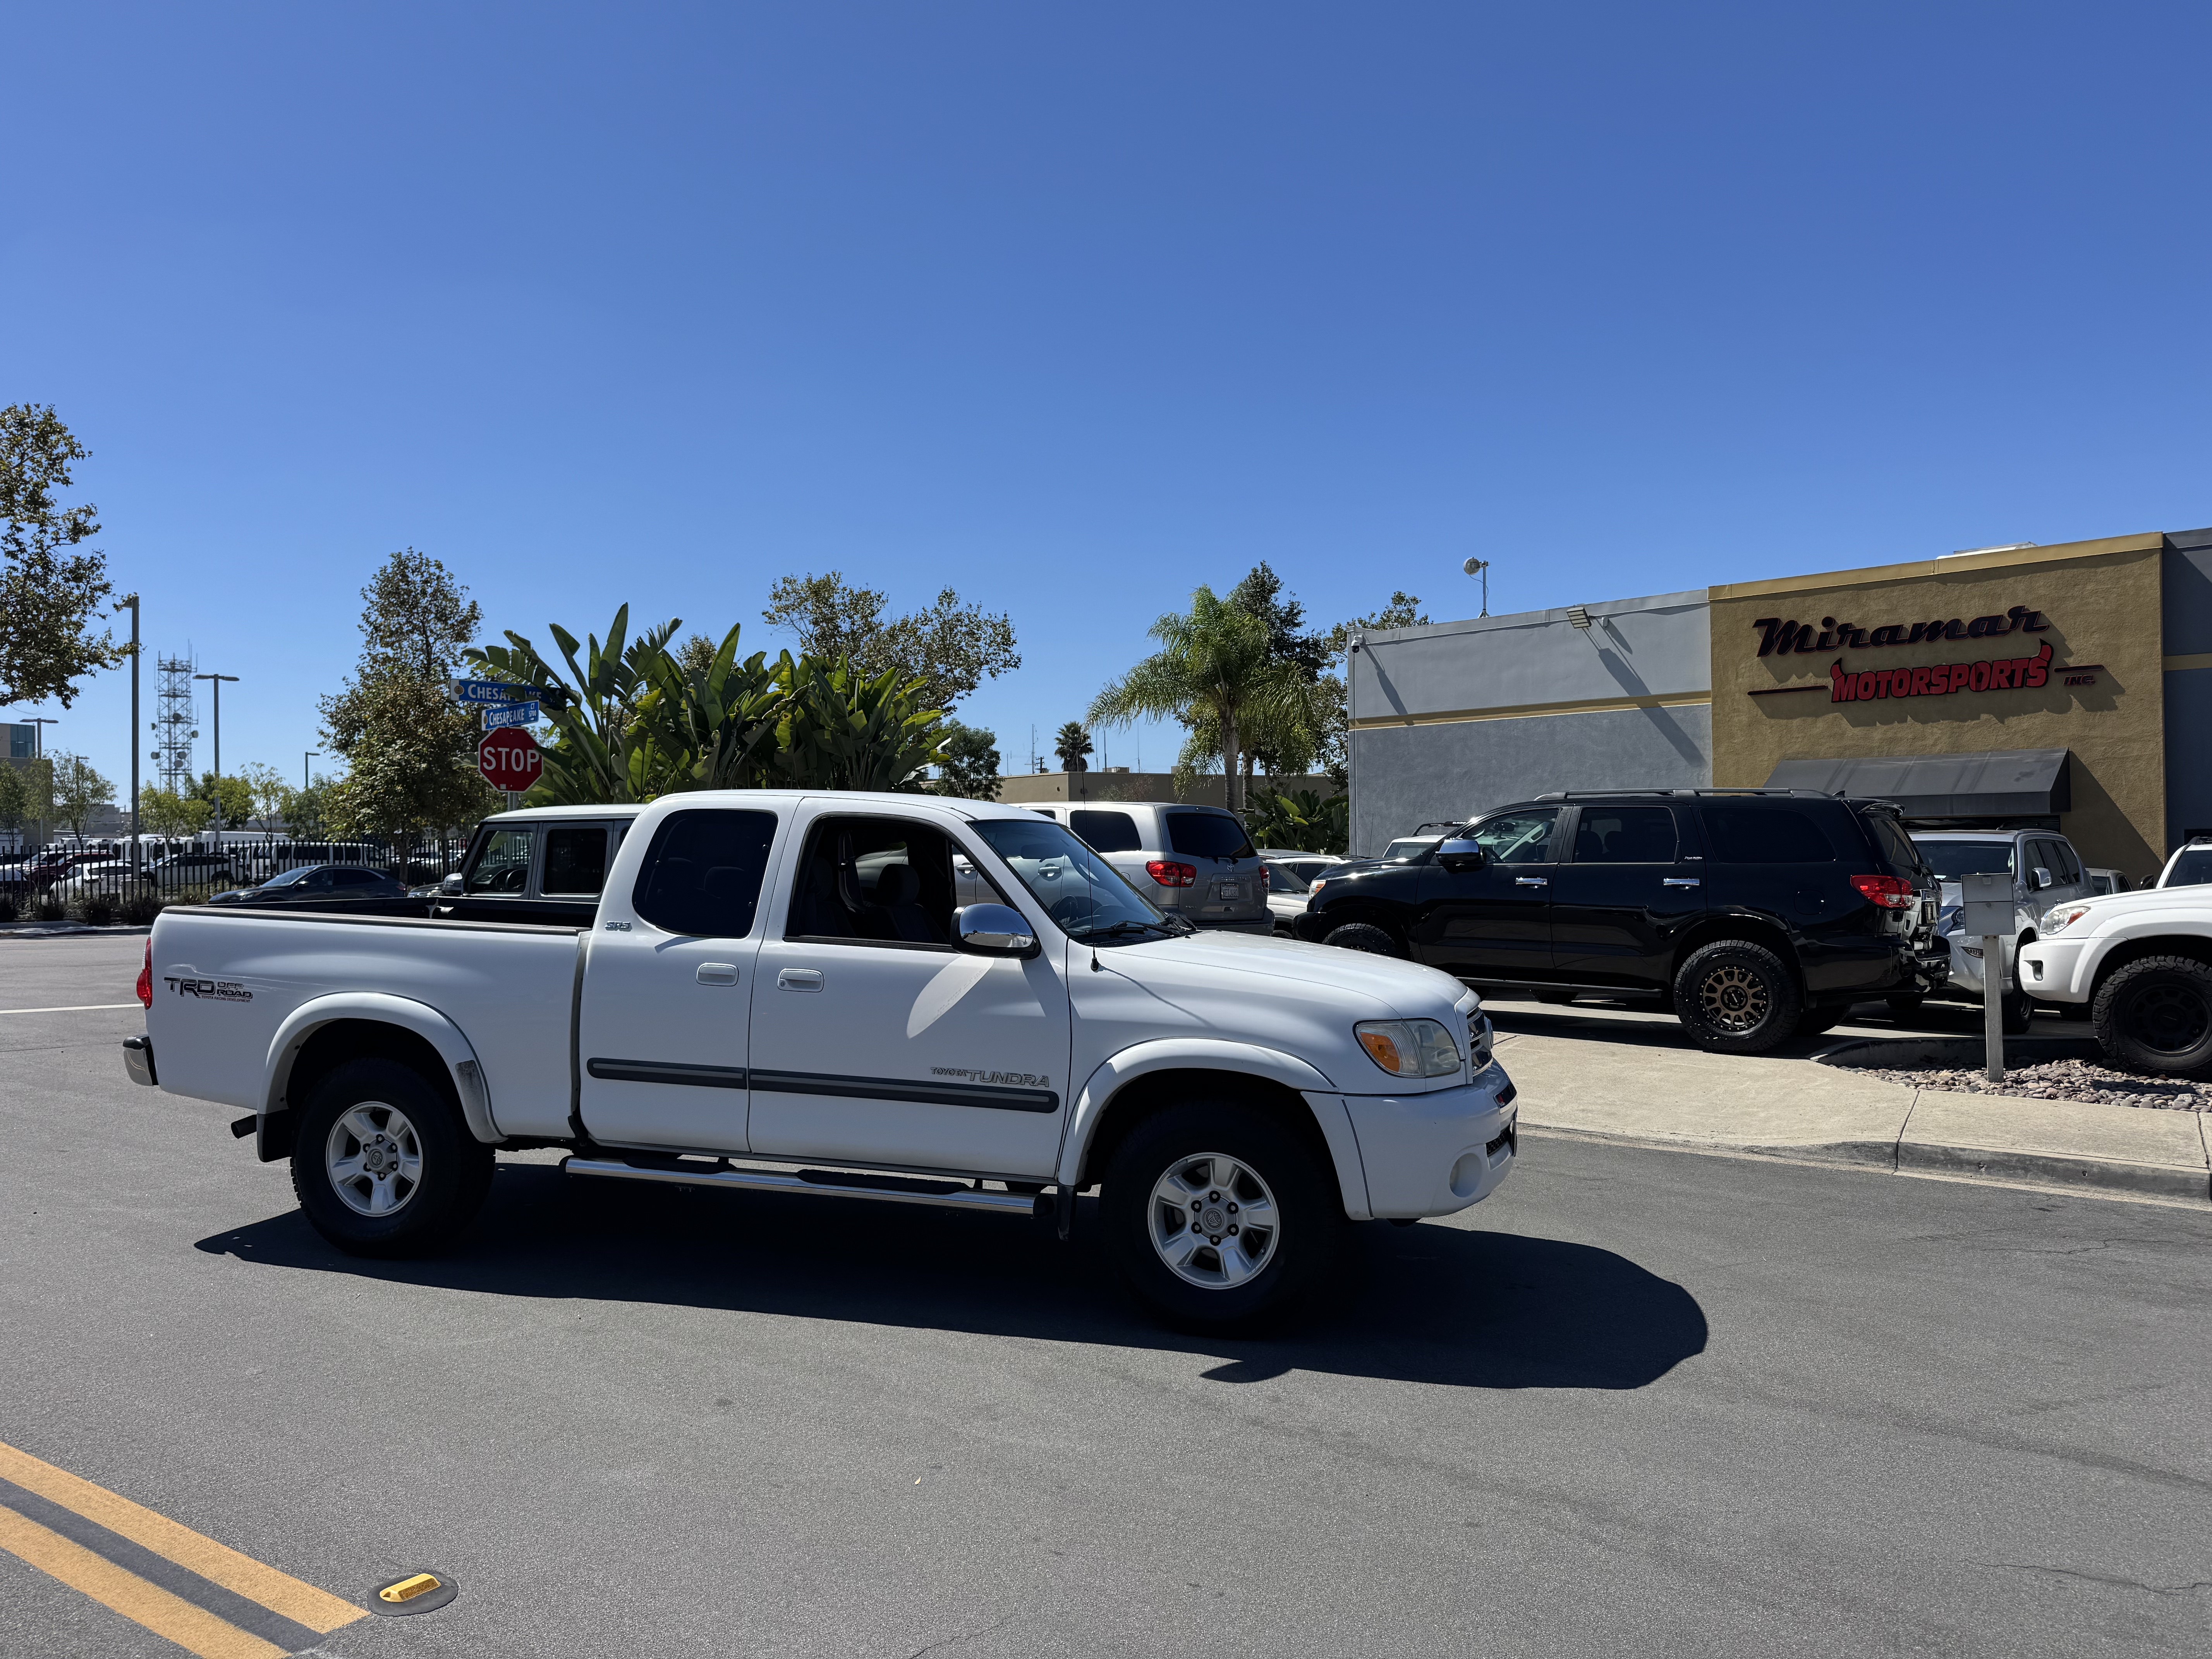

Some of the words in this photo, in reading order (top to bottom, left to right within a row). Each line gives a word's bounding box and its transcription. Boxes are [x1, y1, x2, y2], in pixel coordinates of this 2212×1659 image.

[1752, 605, 2049, 658] Miramar
[1831, 652, 2051, 703] MOTORSPORTS
[2063, 675, 2095, 686] INC.
[489, 709, 524, 726] CHESAPEAKE
[483, 747, 539, 772] STOP
[605, 921, 632, 931] SR5
[164, 977, 215, 998] TRD
[217, 982, 244, 990] OFF
[217, 989, 253, 999] ROAD
[930, 1067, 967, 1077] TOYOTA
[967, 1069, 1049, 1087] TUNDRA
